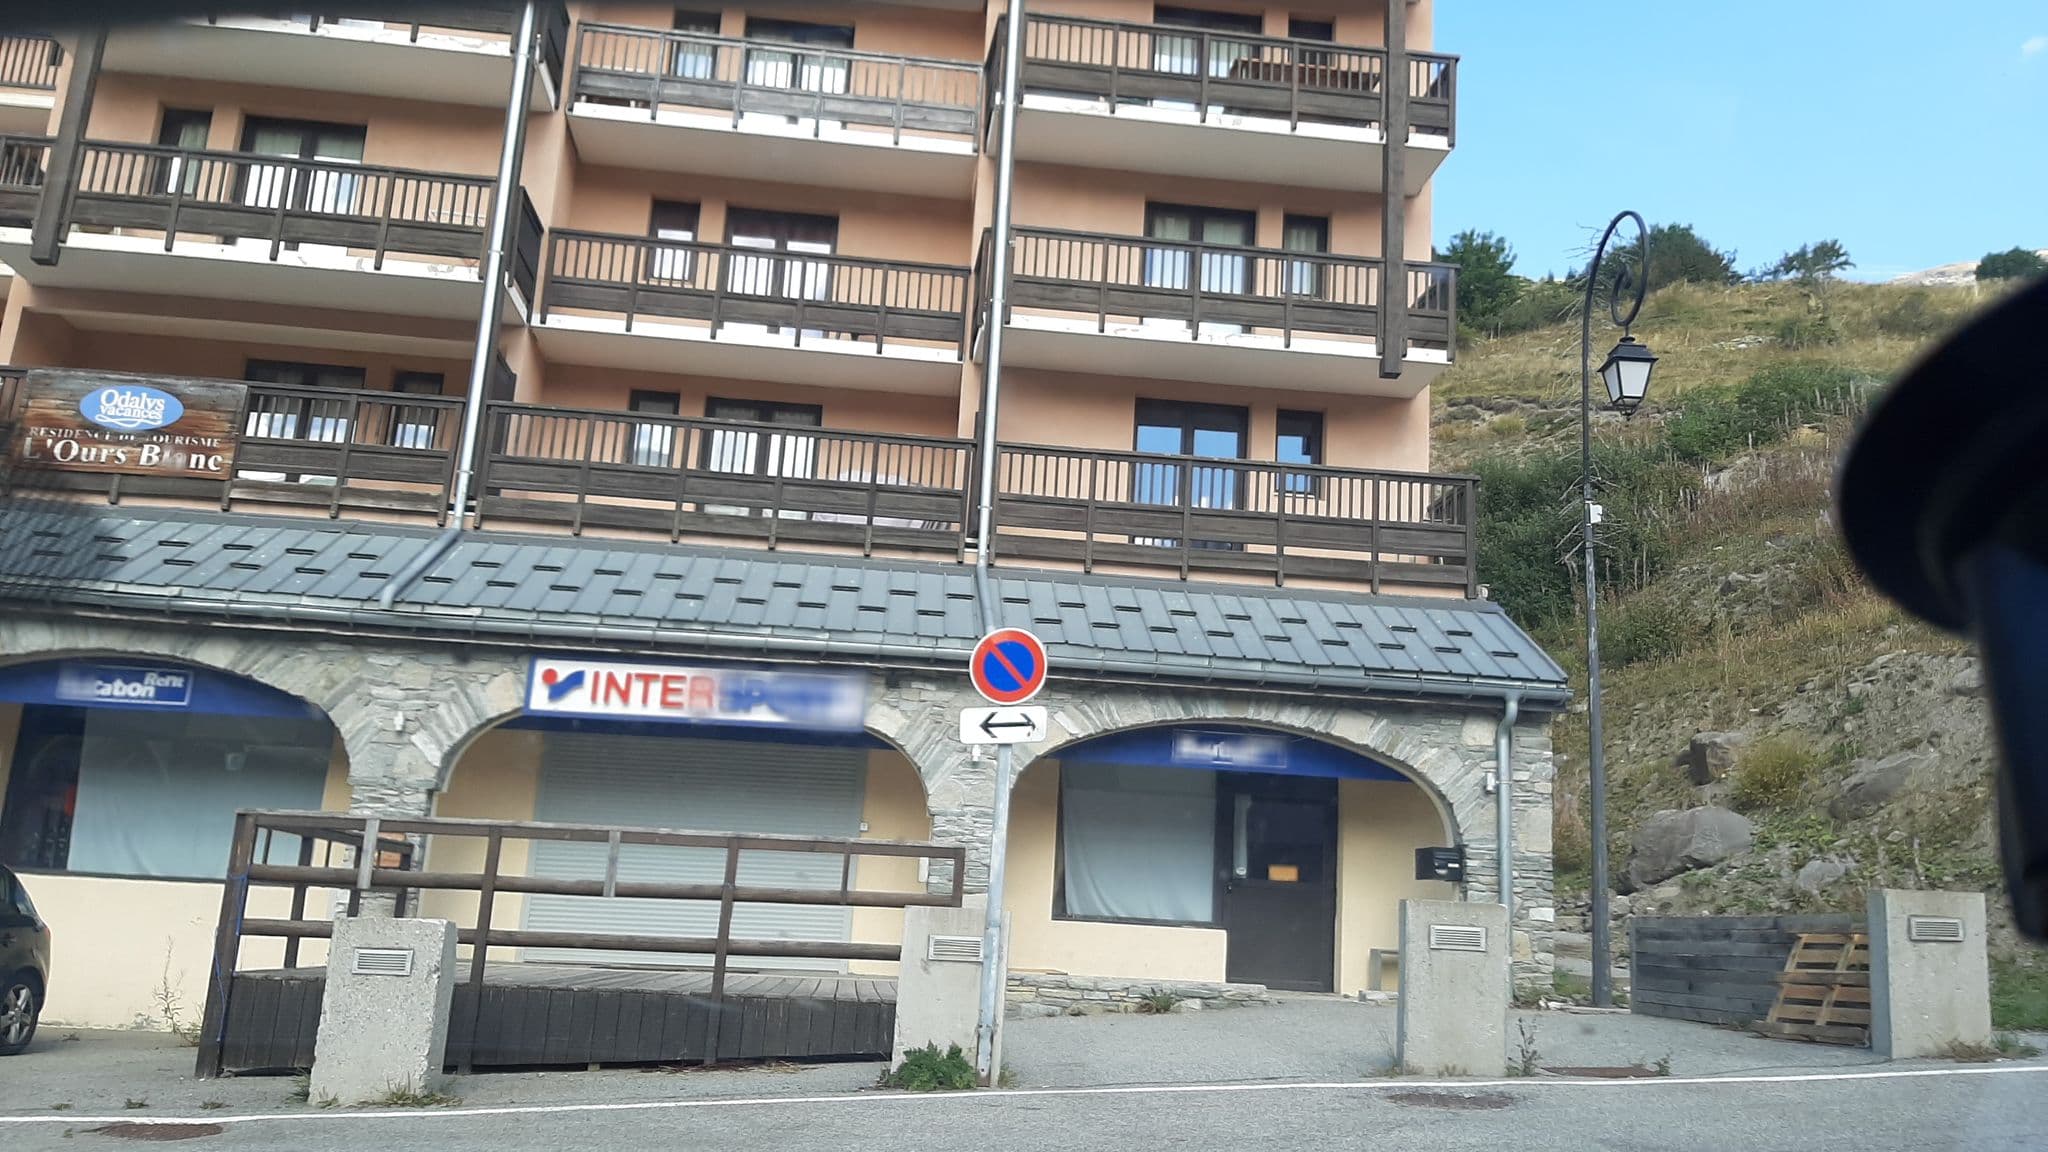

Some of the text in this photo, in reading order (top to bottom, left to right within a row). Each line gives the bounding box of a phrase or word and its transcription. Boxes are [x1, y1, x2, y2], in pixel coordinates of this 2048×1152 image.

[100, 389, 165, 411] Odalys
[24, 437, 126, 464] L'Ours
[144, 433, 221, 447] OURISME
[61, 675, 156, 698] cation
[144, 672, 185, 688] Rent
